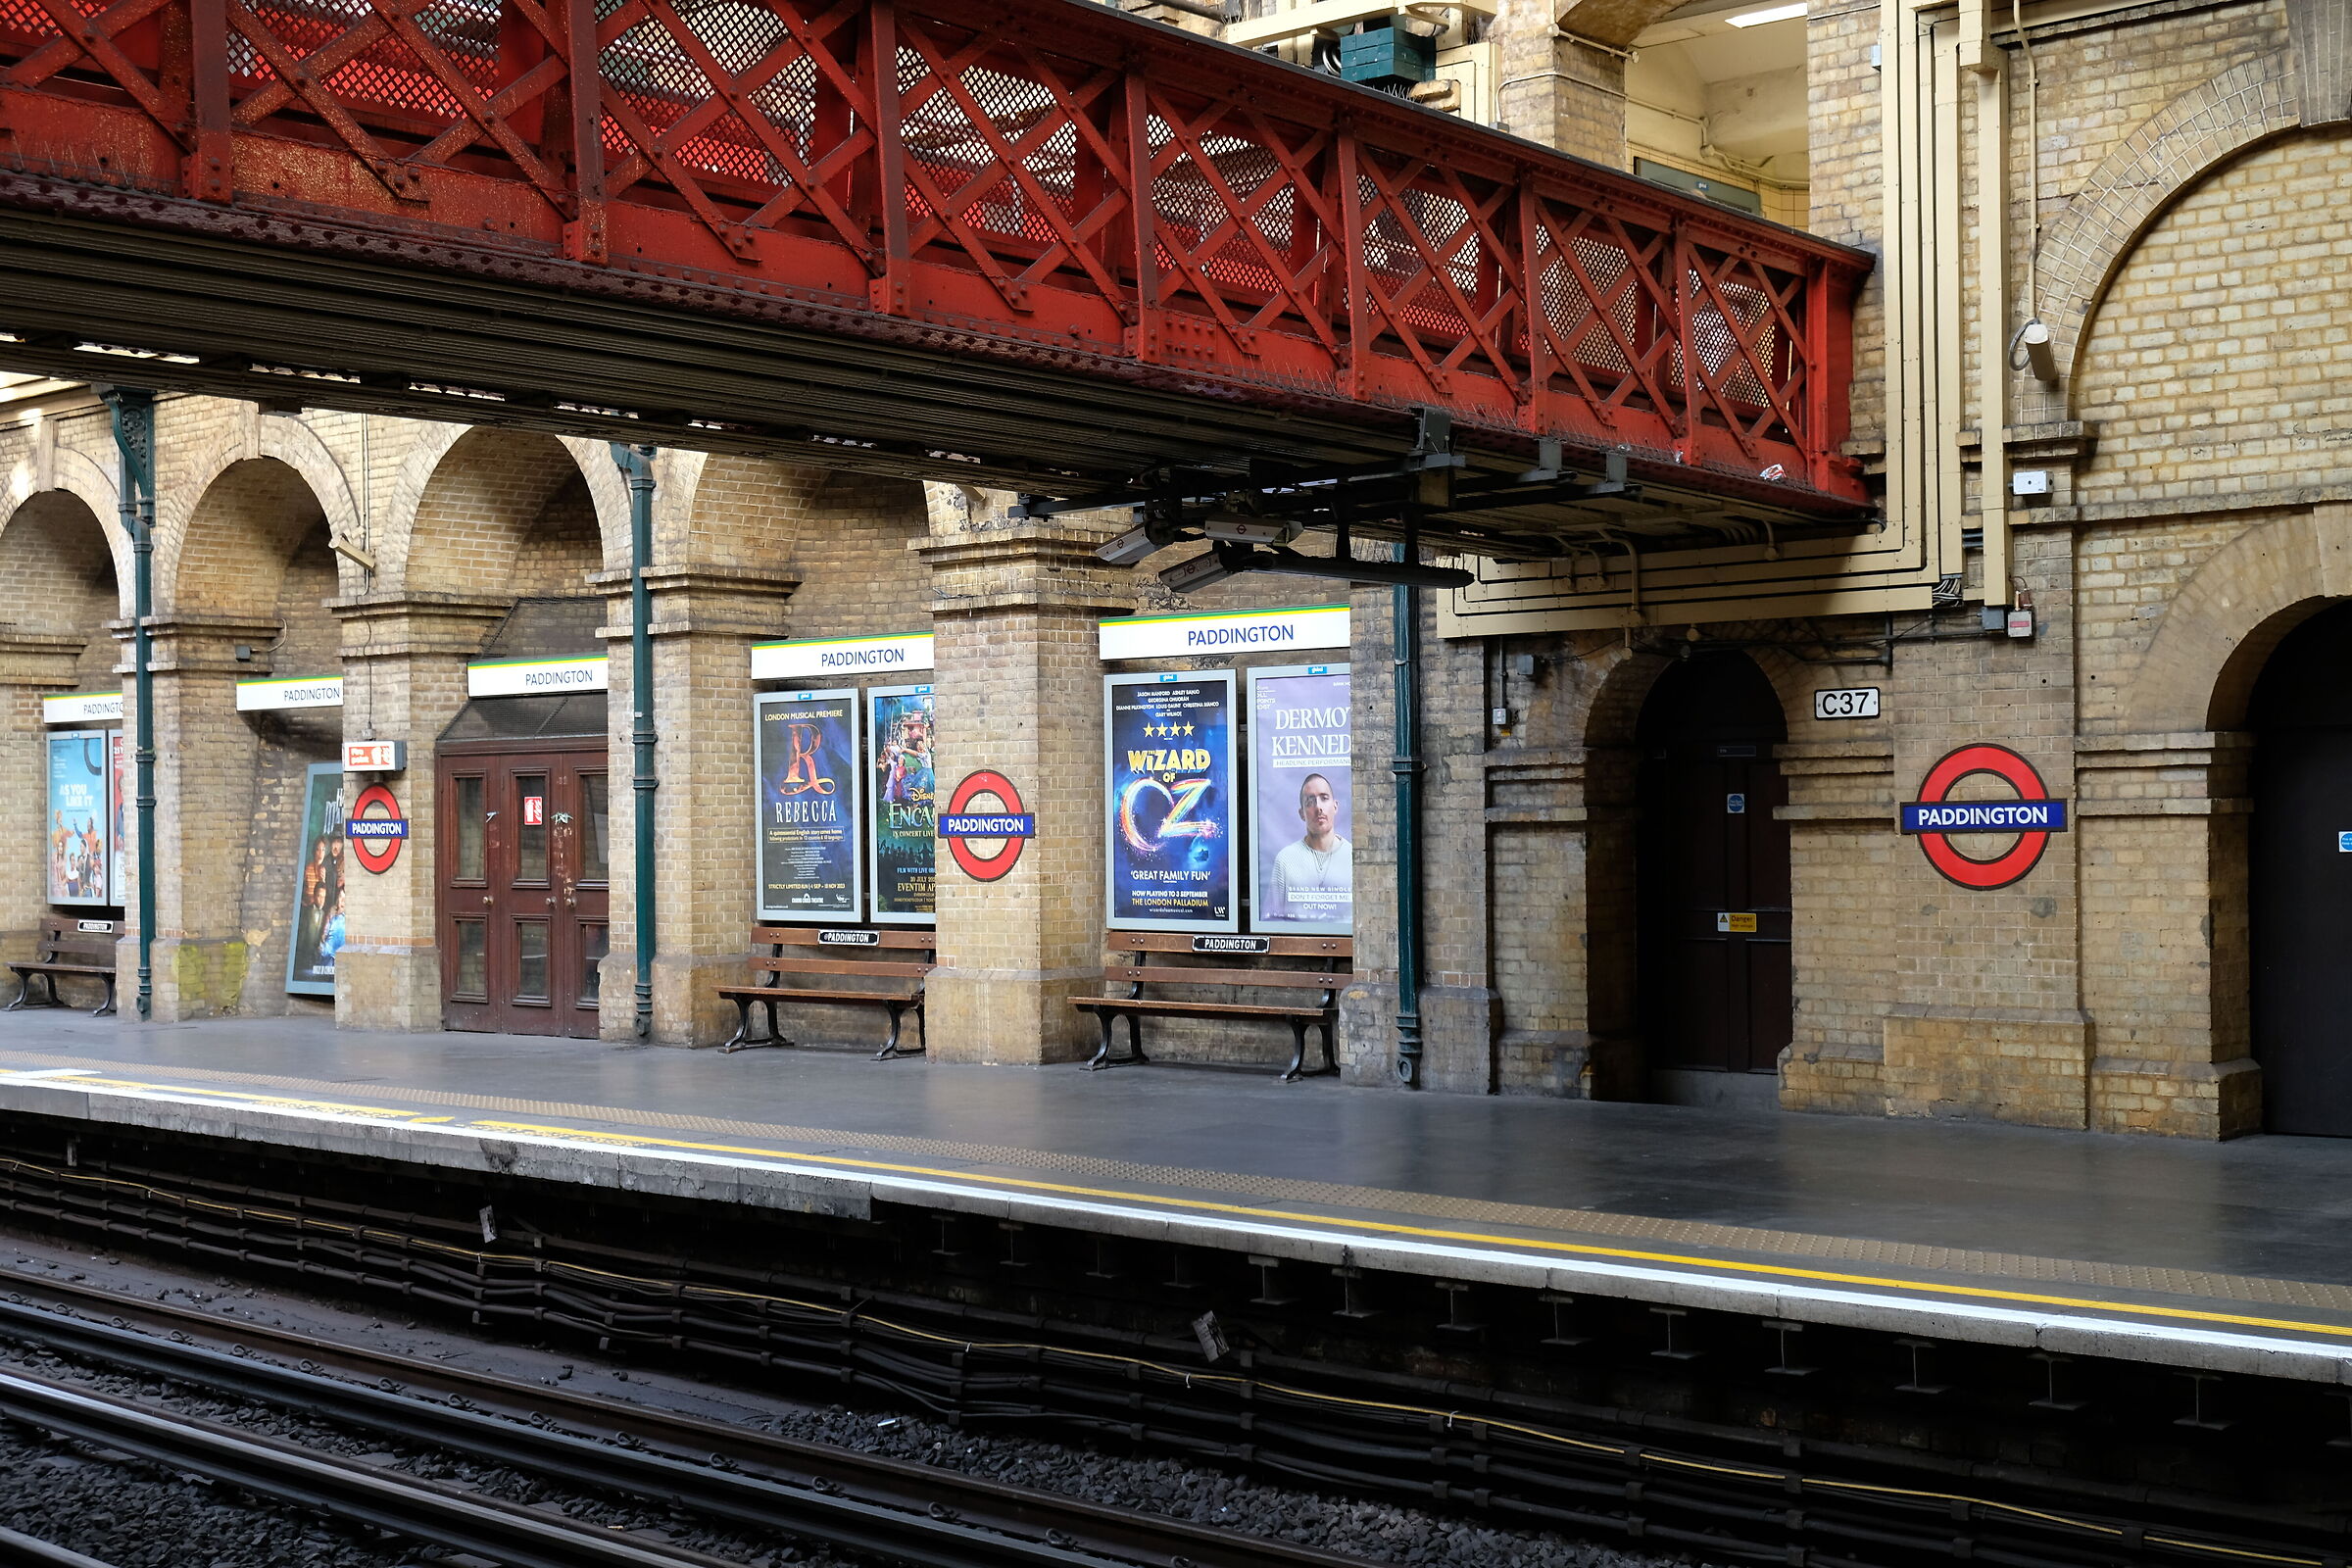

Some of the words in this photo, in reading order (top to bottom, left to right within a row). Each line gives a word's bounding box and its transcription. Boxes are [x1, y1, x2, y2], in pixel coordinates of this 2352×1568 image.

[1188, 624, 1294, 646] PADDINGTON
[821, 648, 904, 666] PADDINGTON
[525, 669, 593, 686] PADDINGTON
[284, 688, 340, 701] PADDINGTON
[1823, 692, 1869, 715] C37
[791, 711, 815, 720] MUSICAL
[816, 710, 843, 718] PREMIERE
[1128, 748, 1211, 772] WIZARD
[1162, 772, 1176, 783] OF
[60, 784, 70, 795] AS
[71, 784, 86, 795] YOU
[66, 795, 82, 807] LIKE
[84, 795, 93, 807] IT
[775, 800, 836, 823] REBECCA
[889, 804, 935, 829] ENCA
[1918, 806, 2047, 826] PADDINGTON
[352, 822, 402, 834] PADDINGTON
[948, 817, 1024, 832] PADDINGTON
[1159, 869, 1189, 880] FAMILY
[898, 883, 926, 892] EVENTIM
[1731, 915, 1753, 924] Danger
[828, 932, 869, 943] PADDINGTON
[1204, 938, 1256, 950] PADDINGTON
